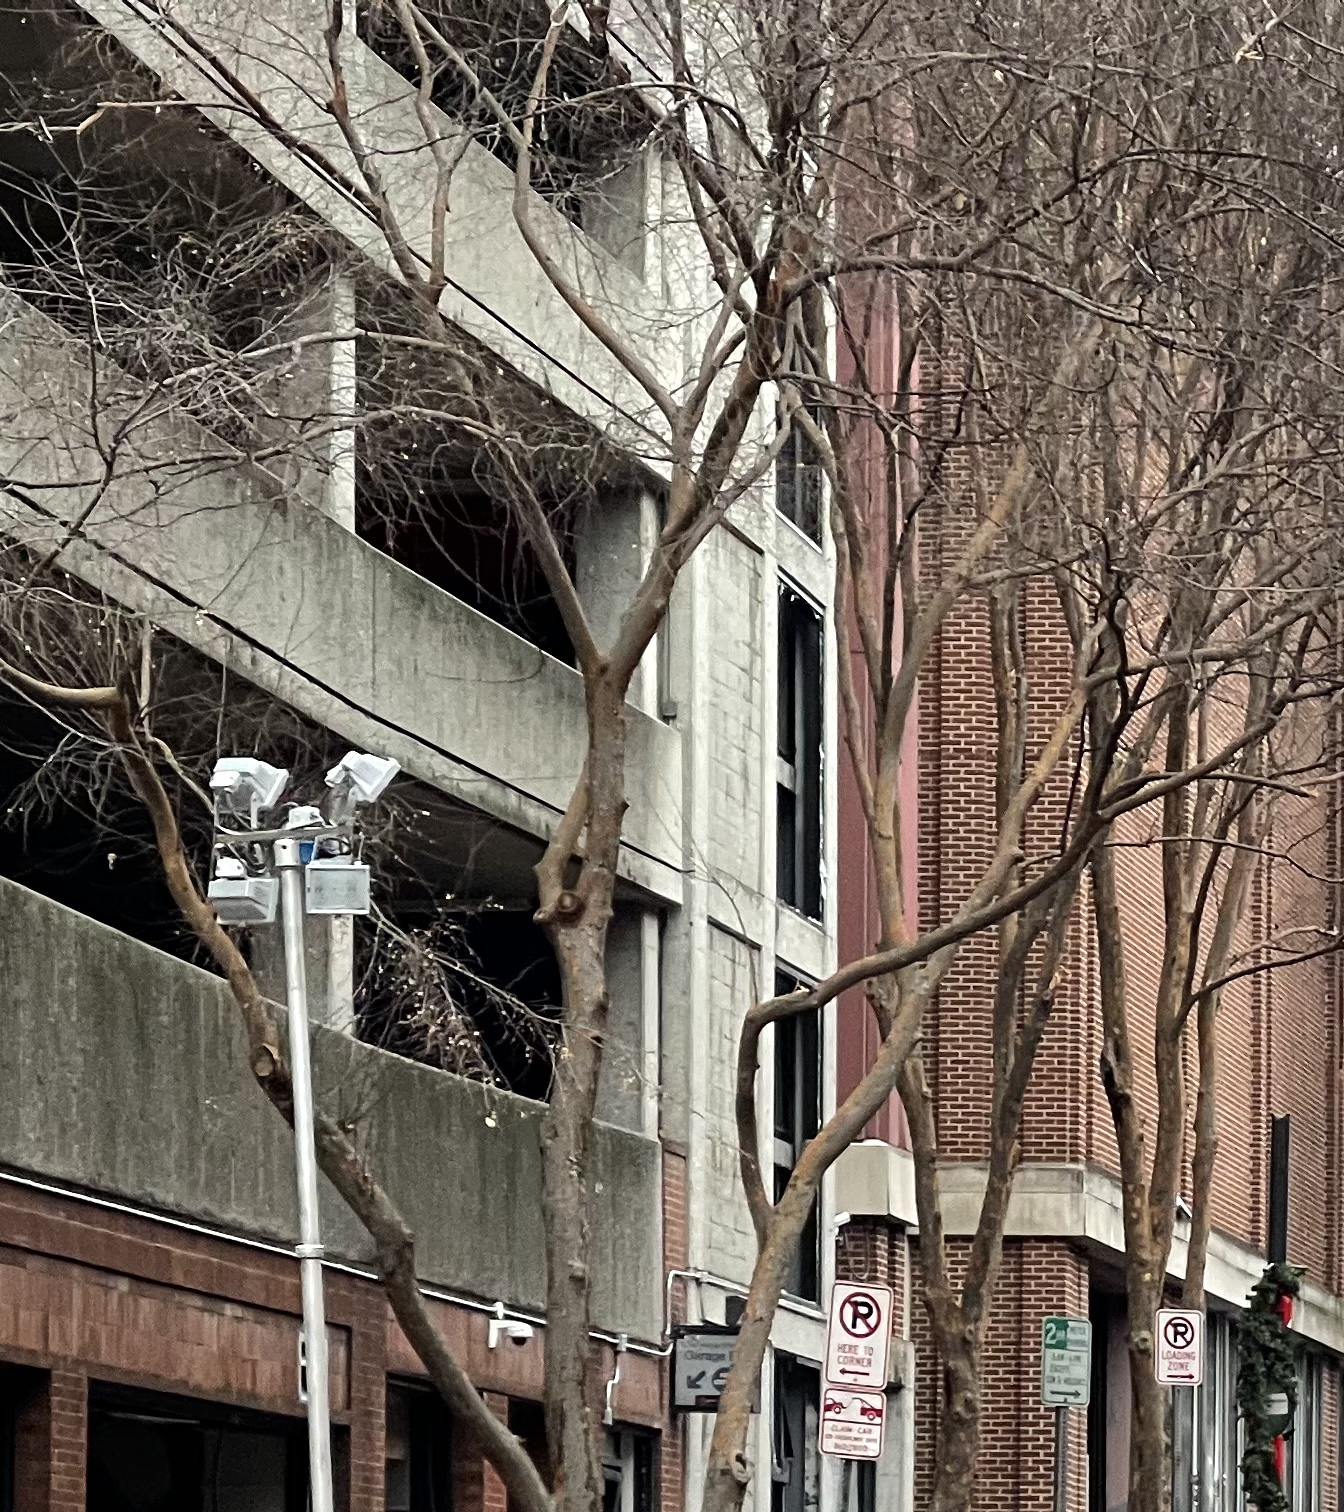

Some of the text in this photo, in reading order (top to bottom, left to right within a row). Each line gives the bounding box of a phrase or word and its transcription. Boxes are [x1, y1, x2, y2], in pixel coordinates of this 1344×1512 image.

[837, 1344, 874, 1356] HERE TO
[1161, 1350, 1196, 1361] LOADING
[837, 1355, 872, 1367] CORNER
[1167, 1361, 1190, 1371] ZONE
